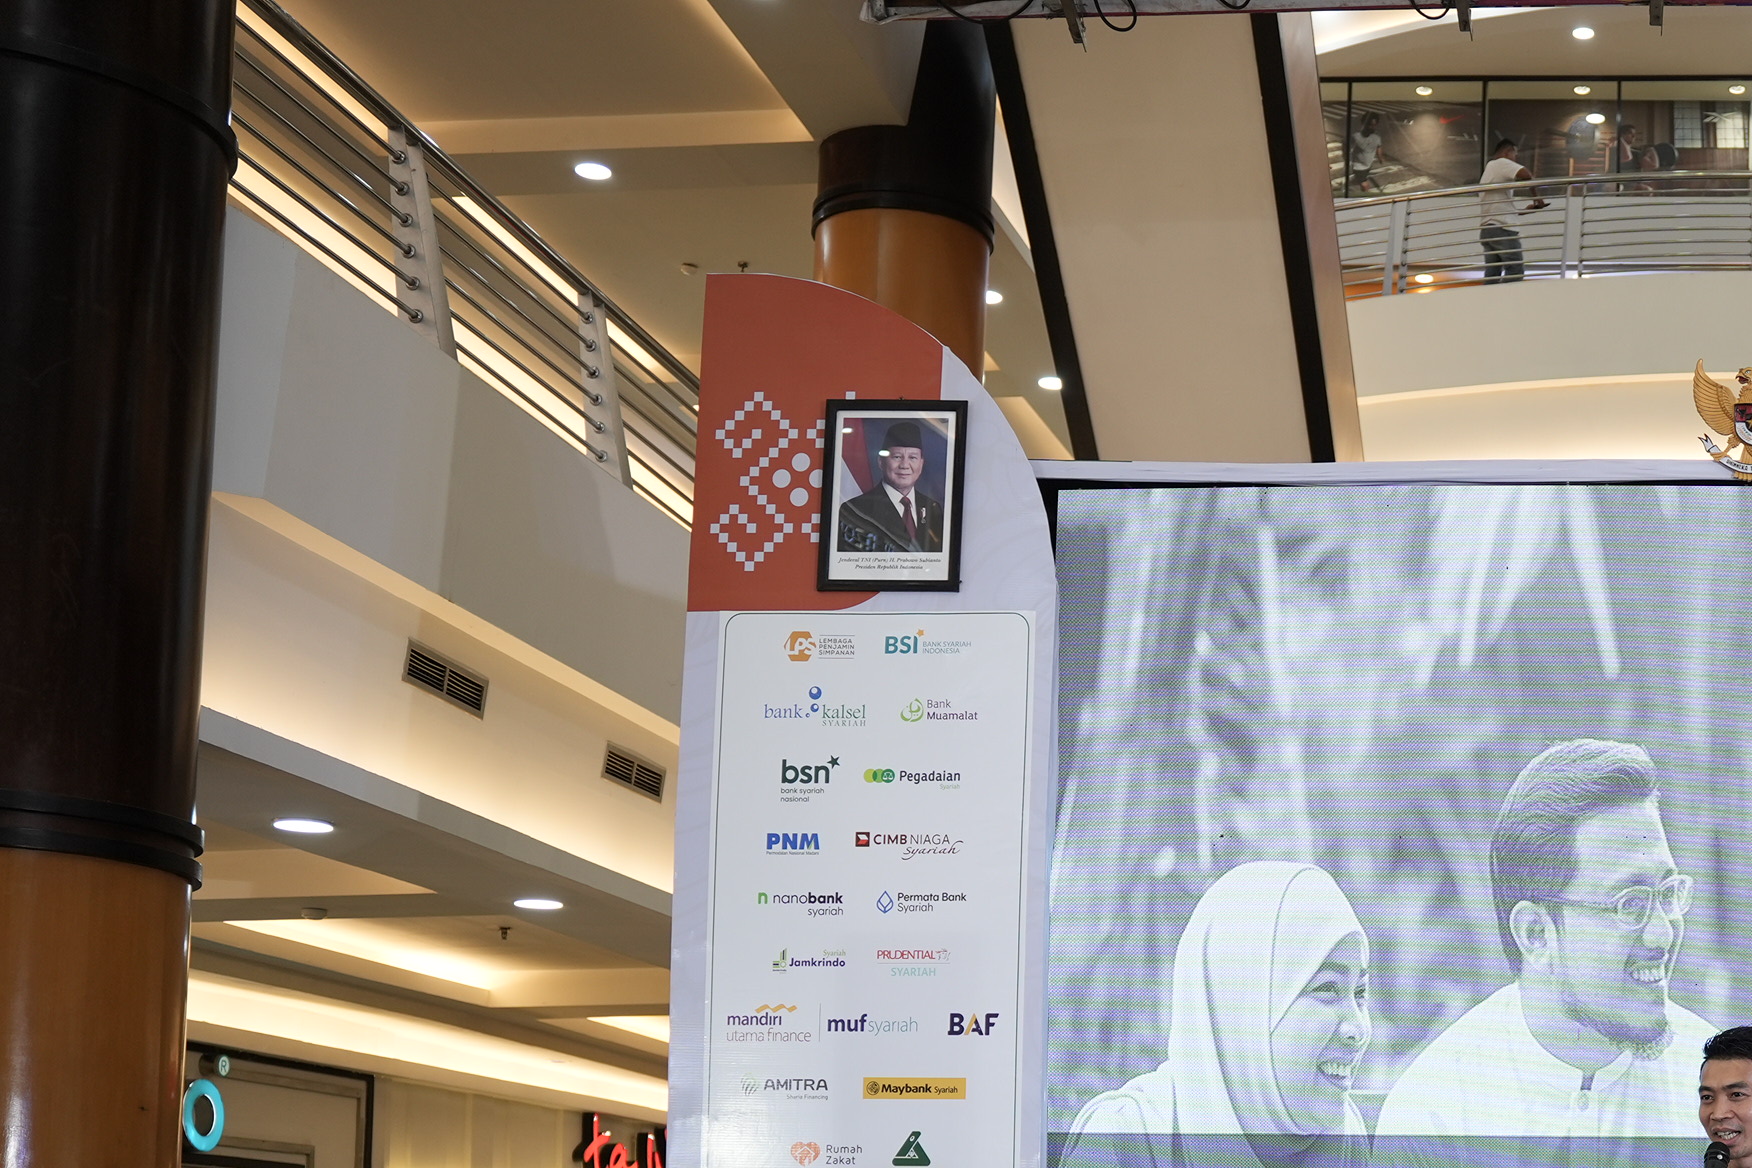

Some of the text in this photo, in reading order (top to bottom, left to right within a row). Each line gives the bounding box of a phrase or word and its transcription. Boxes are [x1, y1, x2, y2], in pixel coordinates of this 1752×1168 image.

[885, 635, 919, 655] BSI
[926, 698, 951, 709] Bank
[764, 703, 867, 720] bank kalsel
[926, 710, 978, 721] Muamalat
[821, 719, 867, 727] SYARIAH
[781, 759, 830, 784] bsn
[899, 769, 961, 784] Pegadaian
[780, 787, 825, 796] bank syariah
[766, 832, 820, 850] PNM
[873, 833, 951, 845] CIMB NIAGA
[772, 892, 843, 905] nanobank
[897, 892, 967, 903] Permata Bank
[807, 906, 844, 918] syariah
[897, 903, 934, 913] Syariah
[823, 949, 846, 958] Syariah
[876, 949, 936, 961] PRUDENTIAL
[789, 958, 846, 967] Jamkrindo
[890, 967, 937, 977] SYARIAH
[727, 1012, 783, 1027] mandiri
[947, 1012, 1000, 1036] BAF
[726, 1027, 812, 1042] utama finance
[764, 1078, 829, 1092] AMITRA
[881, 1083, 959, 1096] Maybank Syariah
[826, 1144, 863, 1154] Rumah
[826, 1155, 856, 1165] Zakat
